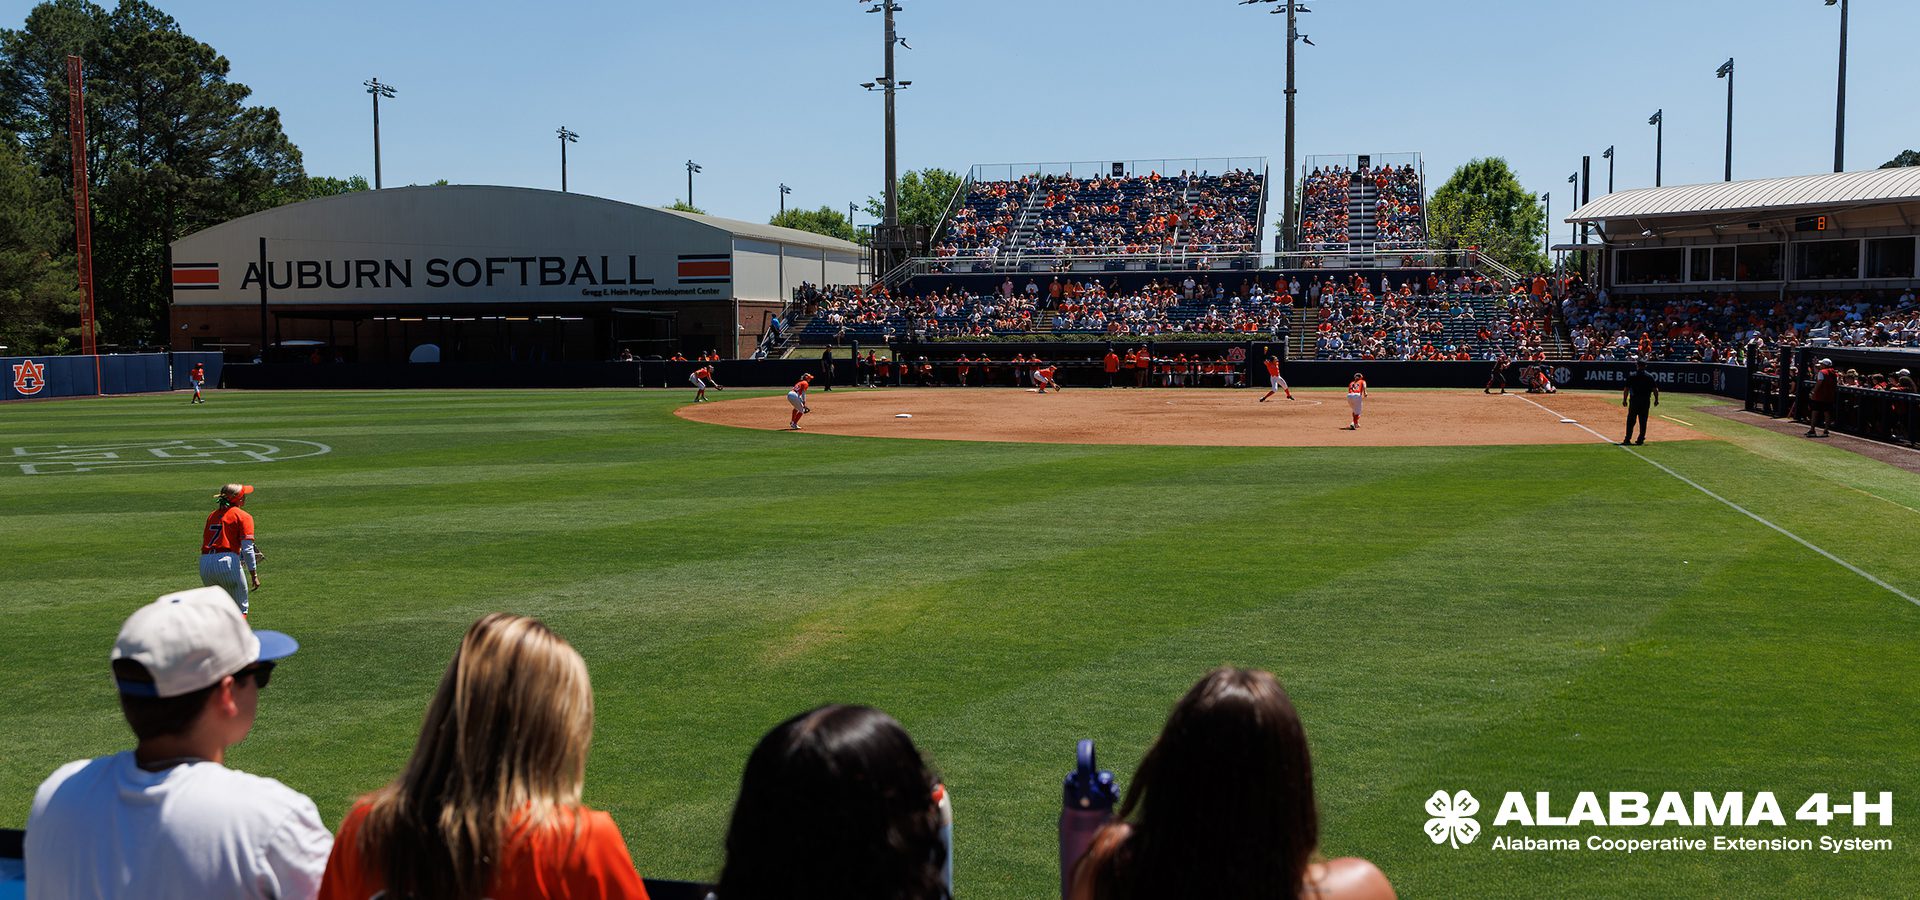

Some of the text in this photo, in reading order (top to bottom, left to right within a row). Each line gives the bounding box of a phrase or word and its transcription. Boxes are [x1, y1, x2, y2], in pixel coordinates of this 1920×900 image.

[1817, 216, 1826, 230] 8
[239, 255, 655, 290] AUBURN SOFTBALL
[582, 287, 720, 297] Gregg E. Heim Player Development Center
[1554, 367, 1571, 384] SEC
[1583, 370, 1614, 381] JANE
[1616, 370, 1627, 382] B.
[1677, 371, 1710, 384] FIELD
[208, 524, 222, 548] 7
